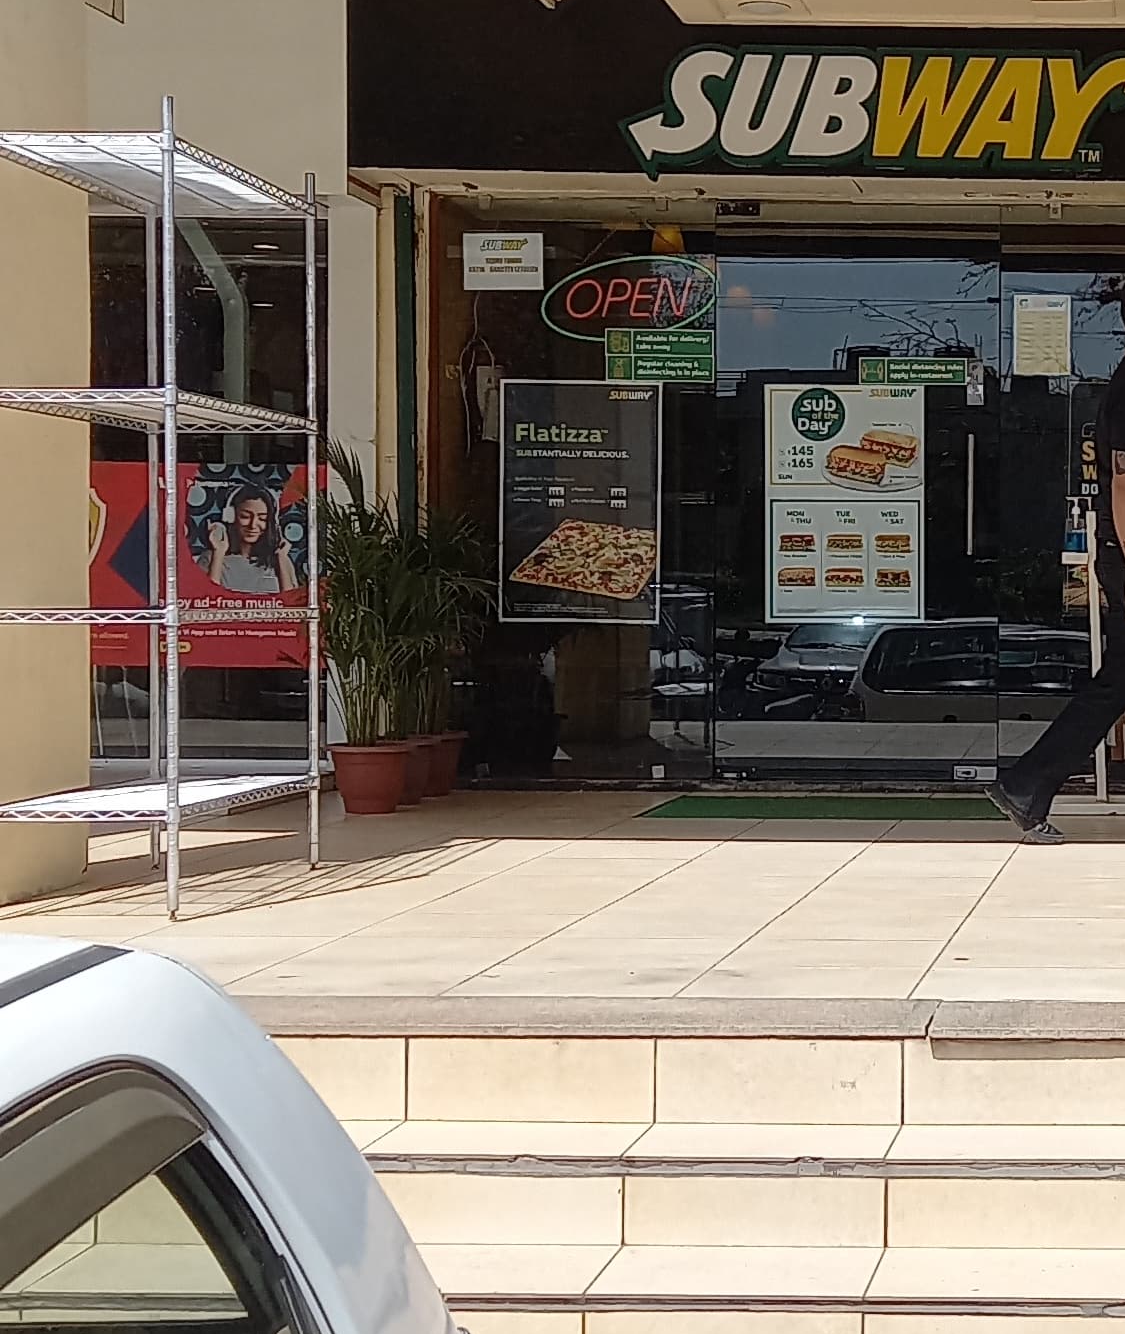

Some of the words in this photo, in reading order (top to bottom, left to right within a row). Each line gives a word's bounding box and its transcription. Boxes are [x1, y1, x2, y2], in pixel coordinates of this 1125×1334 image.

[480, 237, 529, 251] SUBWAY
[566, 276, 692, 318] OPEN
[608, 390, 653, 401] SUBWAY
[868, 387, 917, 398] SUBWAY
[800, 395, 837, 413] sub
[811, 412, 822, 420] of
[823, 412, 839, 421] the
[797, 416, 833, 435] Day
[515, 422, 604, 444] Flatizza
[515, 449, 581, 459] SUBSTANTIALLY
[786, 510, 805, 518] MON
[880, 510, 900, 518] WED
[795, 517, 812, 525] THU
[889, 517, 905, 525] SAT
[194, 596, 243, 609] ad-free
[245, 597, 284, 609] music
